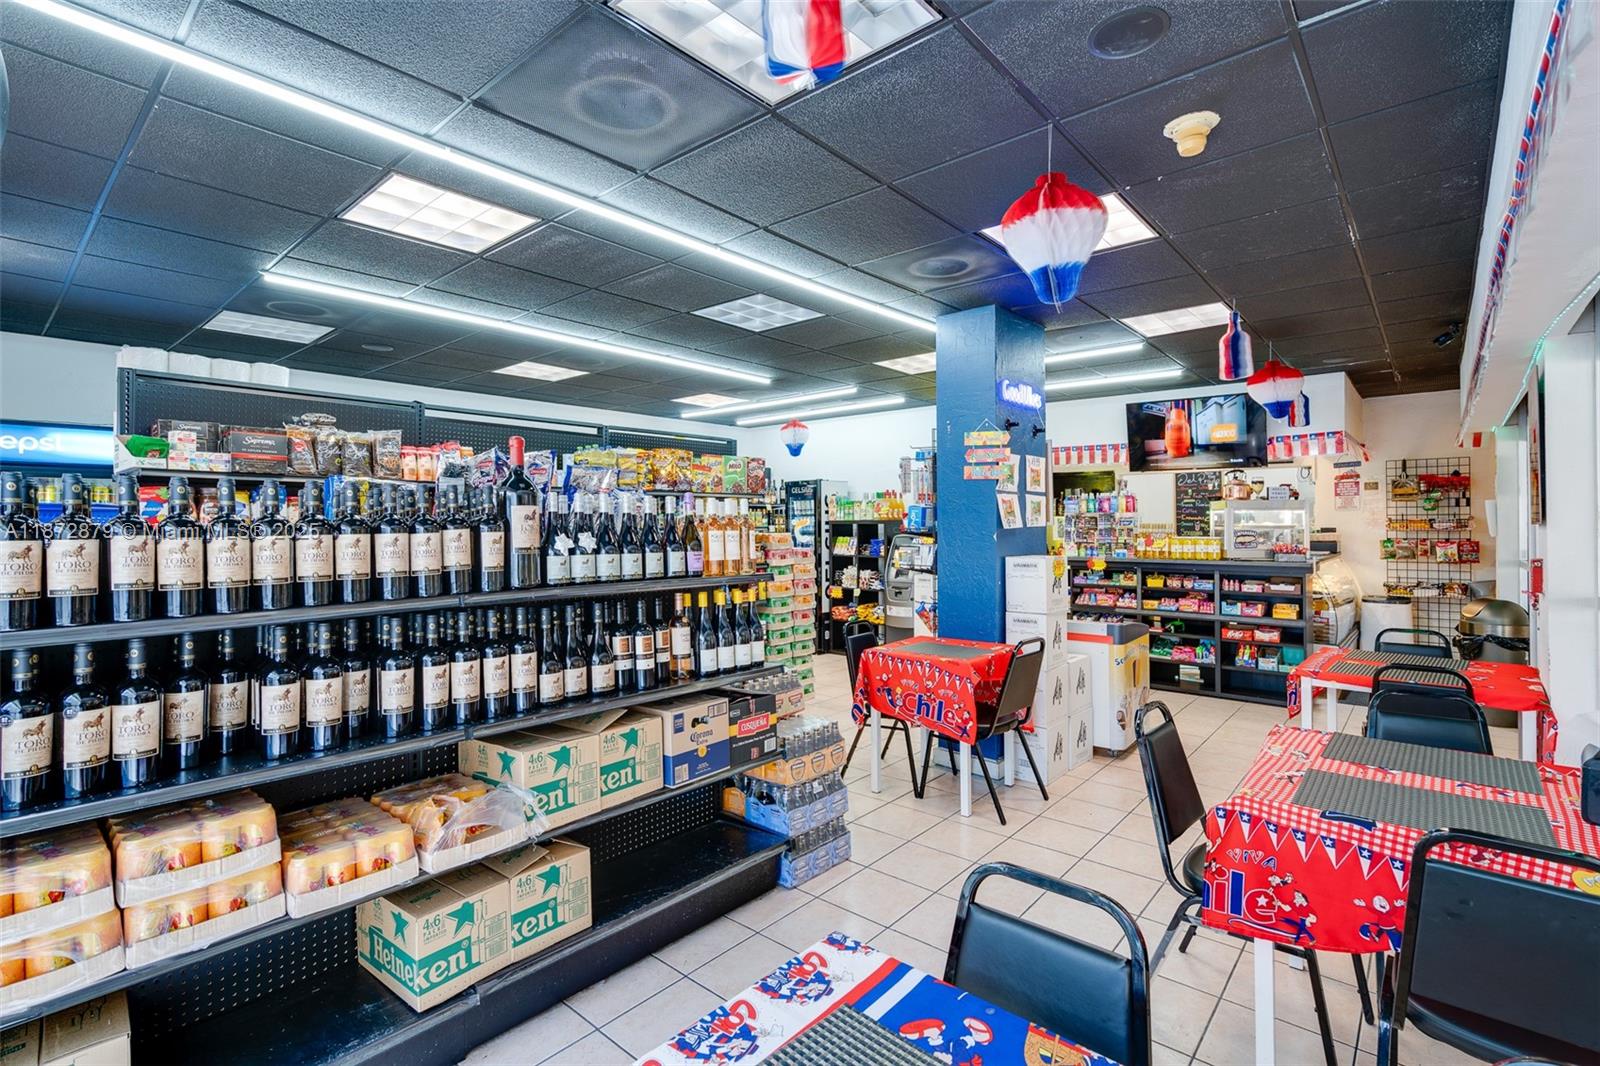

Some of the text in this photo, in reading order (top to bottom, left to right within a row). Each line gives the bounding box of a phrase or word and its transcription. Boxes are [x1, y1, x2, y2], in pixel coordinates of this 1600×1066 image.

[164, 556, 196, 564] TORO
[341, 552, 366, 560] TORO
[56, 561, 92, 570] TORO
[216, 700, 242, 709] TORO
[312, 696, 338, 705] TORO
[270, 702, 296, 712] TORO
[902, 691, 956, 728] Chile
[119, 724, 151, 734] TORO
[690, 728, 714, 742] Corona
[15, 736, 50, 749] TORO
[1226, 848, 1278, 872] VIVA
[423, 914, 441, 931] 4x6
[373, 932, 468, 990] Heineken
